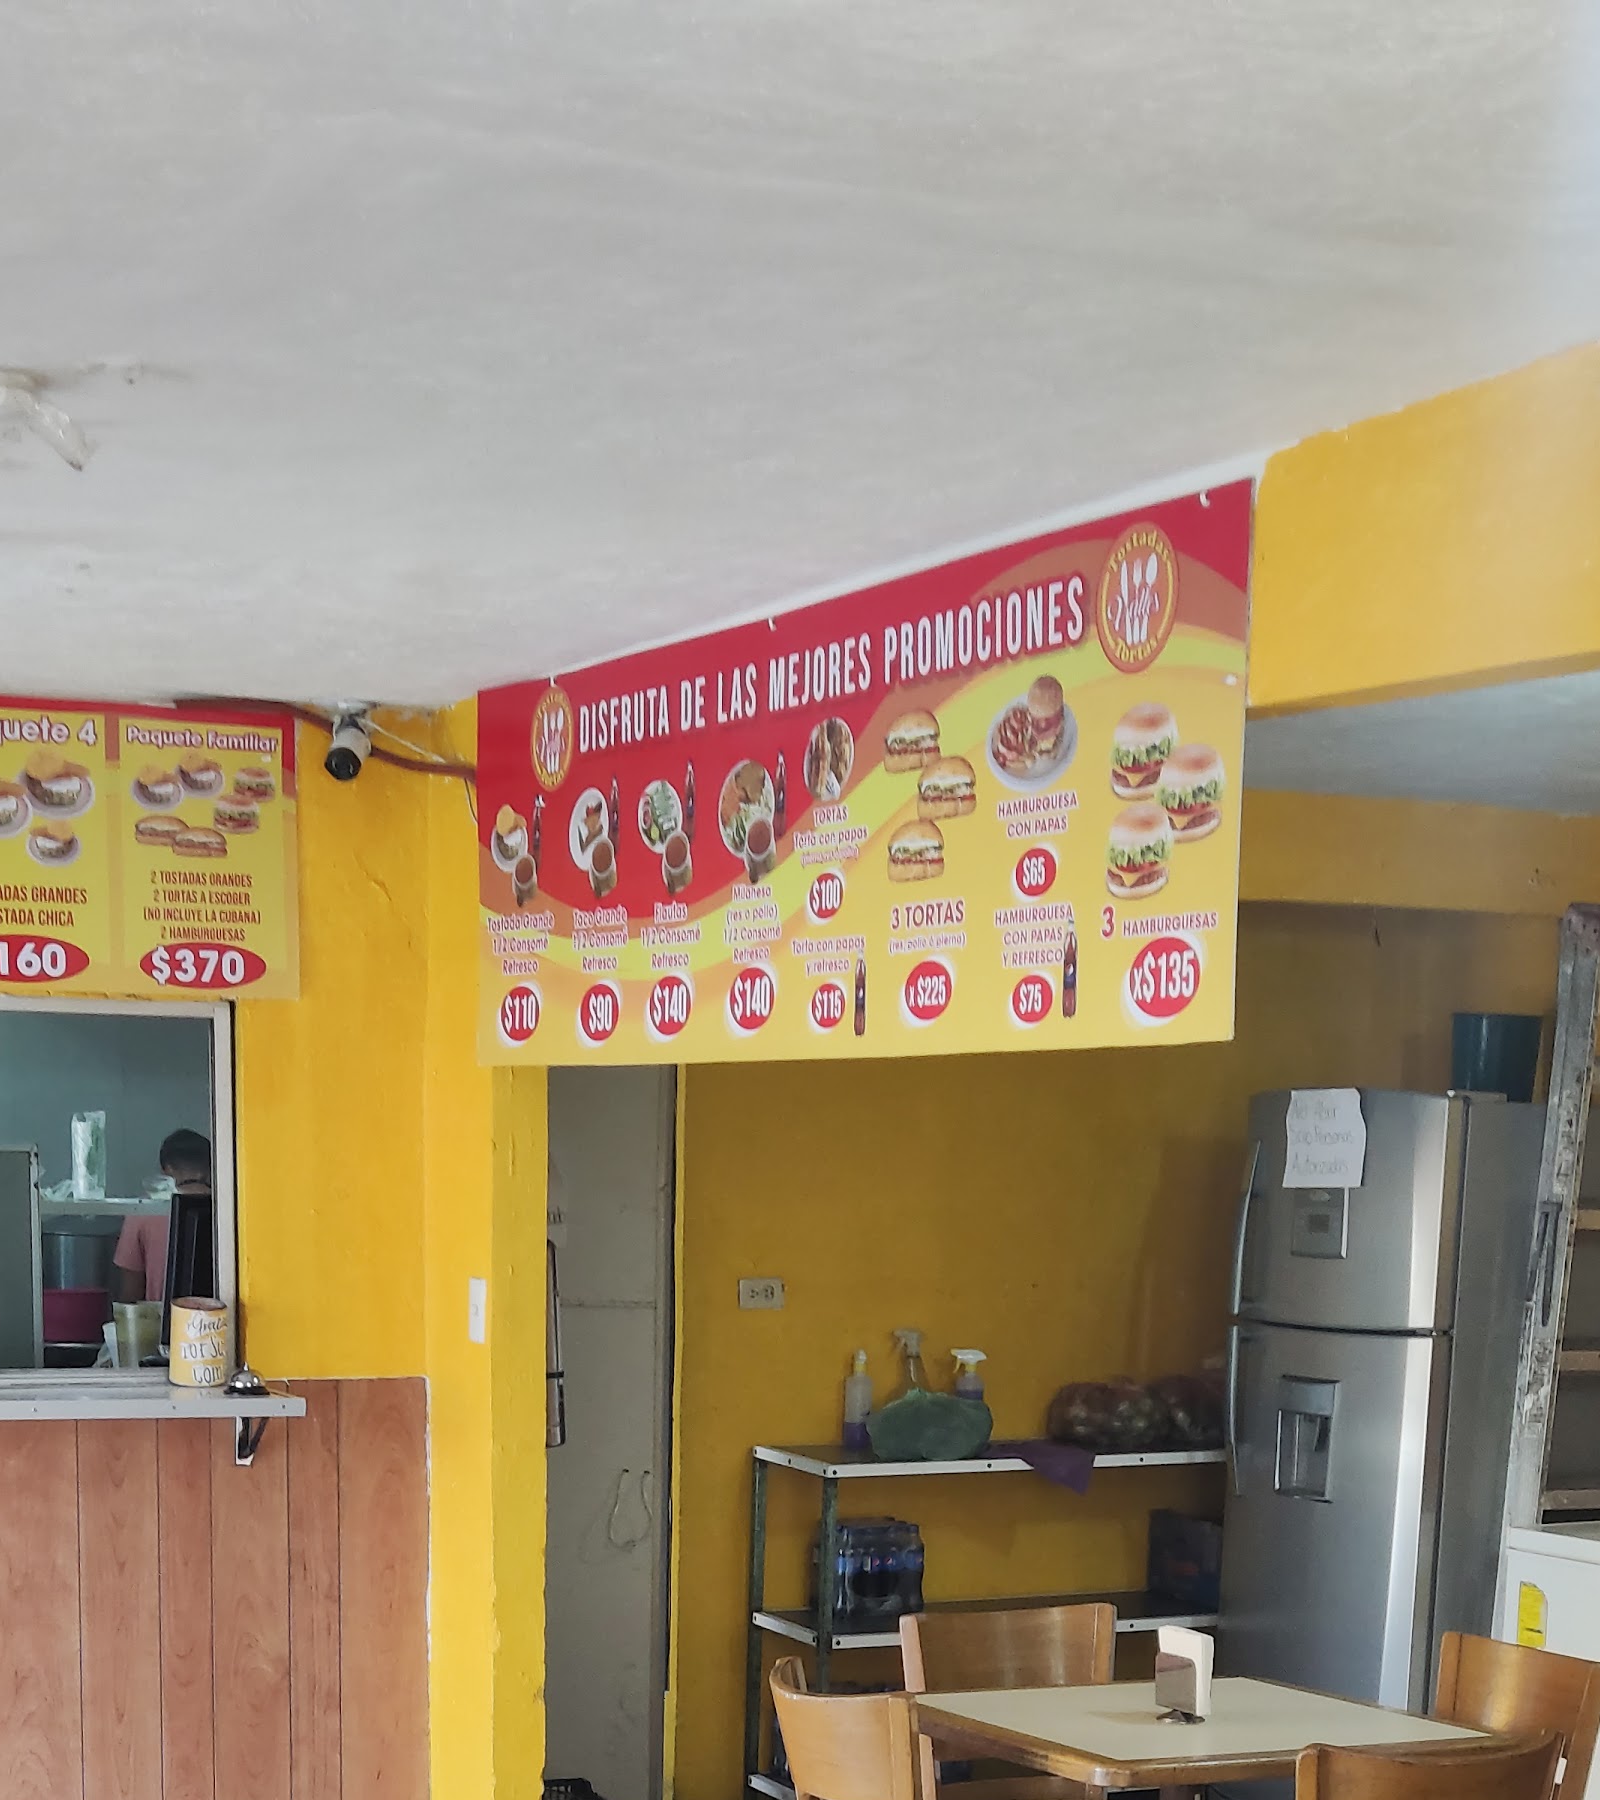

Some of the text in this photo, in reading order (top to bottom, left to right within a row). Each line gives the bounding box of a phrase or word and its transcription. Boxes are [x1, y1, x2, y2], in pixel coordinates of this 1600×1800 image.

[1108, 529, 1169, 573] Tostadas
[579, 685, 670, 753] DISFRUTA
[680, 677, 706, 731] DE
[717, 663, 757, 723] LAS
[768, 634, 872, 712] MEJORES
[884, 576, 1084, 684] PROMOCIONES
[77, 719, 98, 746] 4
[126, 725, 278, 752] Paquete Familiar
[815, 806, 848, 826] TORTAS
[998, 792, 1078, 818] HAMBURGUESA
[794, 831, 817, 848] Torta
[838, 827, 868, 844] papas
[1007, 816, 1068, 838] CON PAPAS
[151, 871, 253, 887] 2 TOSTADAS GRANDES
[1022, 856, 1046, 889] $65
[31, 885, 88, 904] GRANDES
[733, 885, 771, 901] Milanesa
[812, 879, 841, 912] $100
[38, 909, 75, 927] CHICA
[573, 905, 628, 929] Taco Grande
[654, 901, 687, 923] Flautas
[891, 900, 965, 930] 3 TORTAS
[995, 903, 1074, 926] HAMBURGUESA
[1101, 906, 1217, 938] 3 HAMBURGUESAS
[169, 927, 246, 942] HAMBURGUESAS
[658, 923, 700, 944] Consomé
[740, 922, 781, 941] Consomé
[1003, 927, 1063, 946] CON PAPAS
[733, 947, 770, 963] Refresco
[792, 937, 865, 954] Torta con papas
[151, 946, 245, 985] $370
[503, 959, 538, 975] Refresco
[583, 956, 617, 972] Refresco
[651, 953, 689, 969] Refresco
[813, 959, 850, 973] refresco
[1002, 949, 1063, 967] Y REFRESCO
[734, 976, 771, 1021] $140
[917, 974, 946, 1008] $225
[1019, 983, 1043, 1014] $75
[504, 995, 536, 1033] $110
[589, 993, 613, 1034] $90
[653, 984, 687, 1026] $140
[815, 989, 842, 1018] $115
